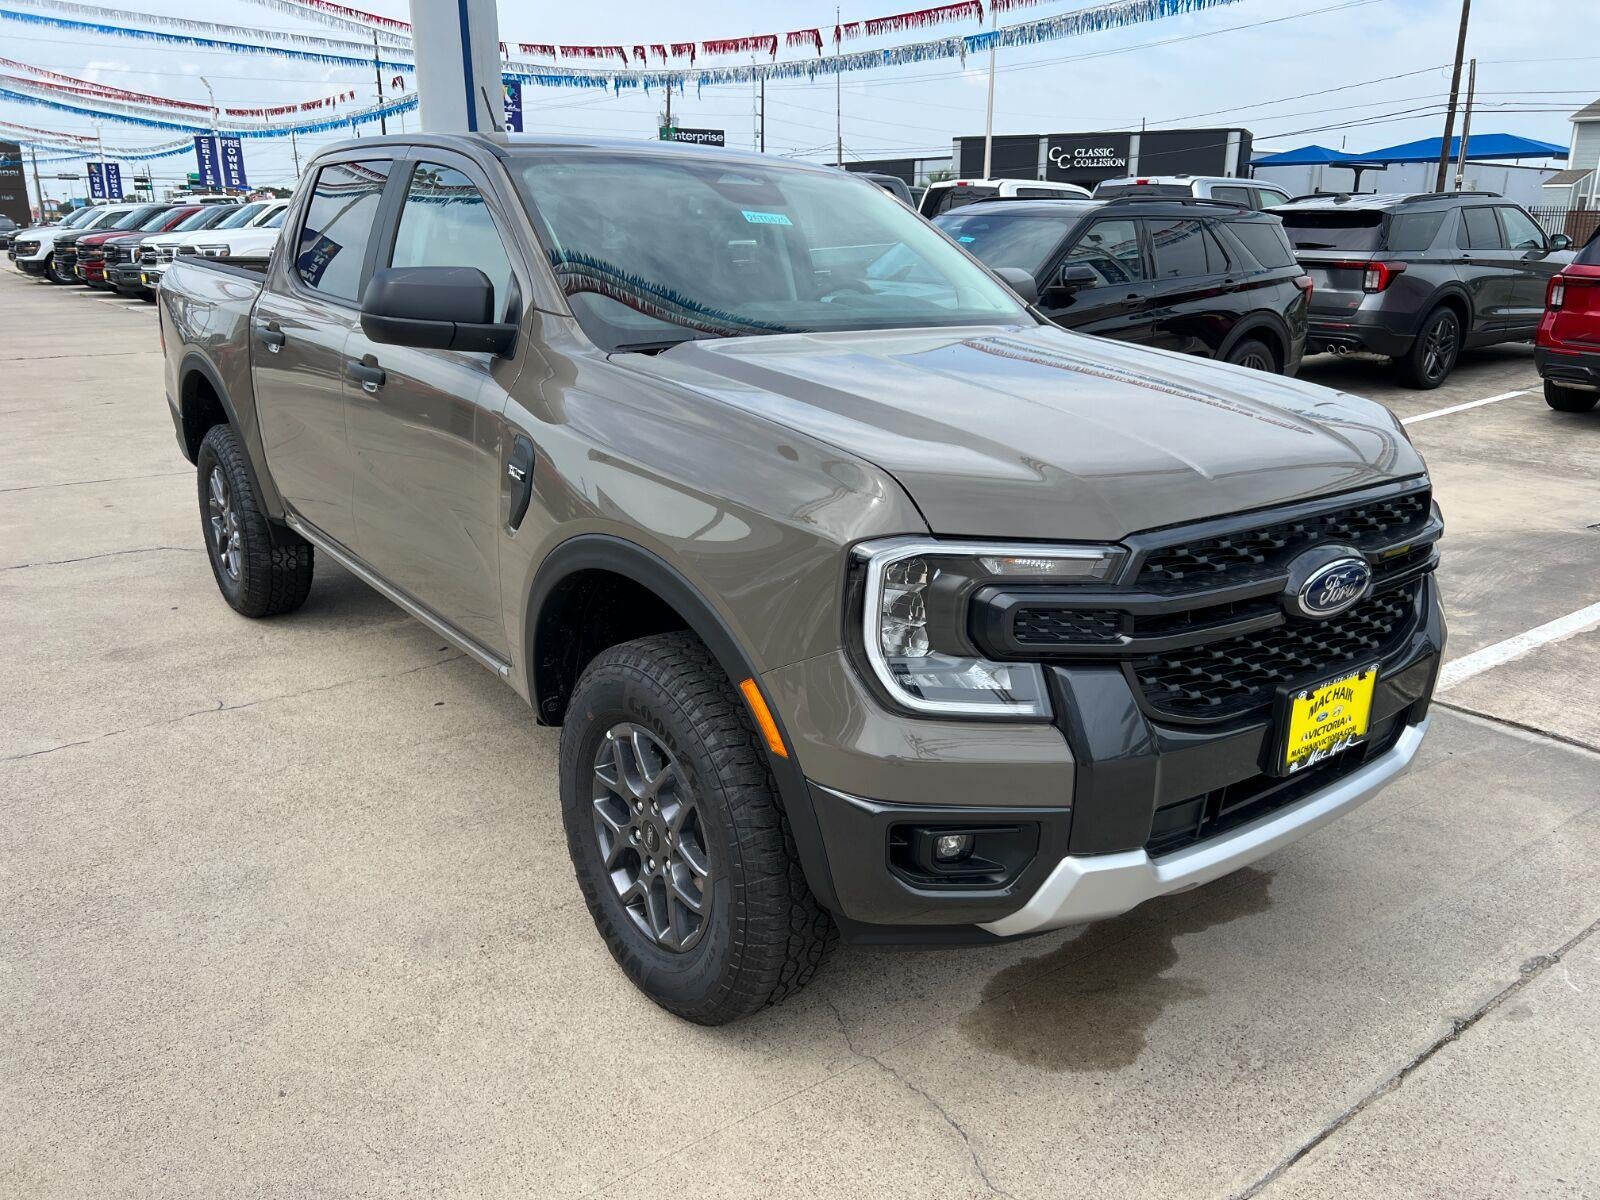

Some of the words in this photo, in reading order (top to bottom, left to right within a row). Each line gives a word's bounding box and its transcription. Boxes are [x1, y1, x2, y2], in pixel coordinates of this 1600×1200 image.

[221, 139, 240, 148] PRE
[663, 131, 724, 144] nterprise
[200, 138, 215, 185] CERTIFIED
[1073, 158, 1126, 167] COLLISION
[1074, 148, 1114, 157] CLASSIC
[227, 147, 240, 186] OWNED
[92, 176, 103, 198] NEW
[108, 165, 119, 198] HYUNDAI
[1319, 571, 1360, 606] Ford
[1308, 690, 1333, 719] MAC
[1332, 686, 1354, 703] HAIK
[1308, 719, 1346, 740] VICTORIA
